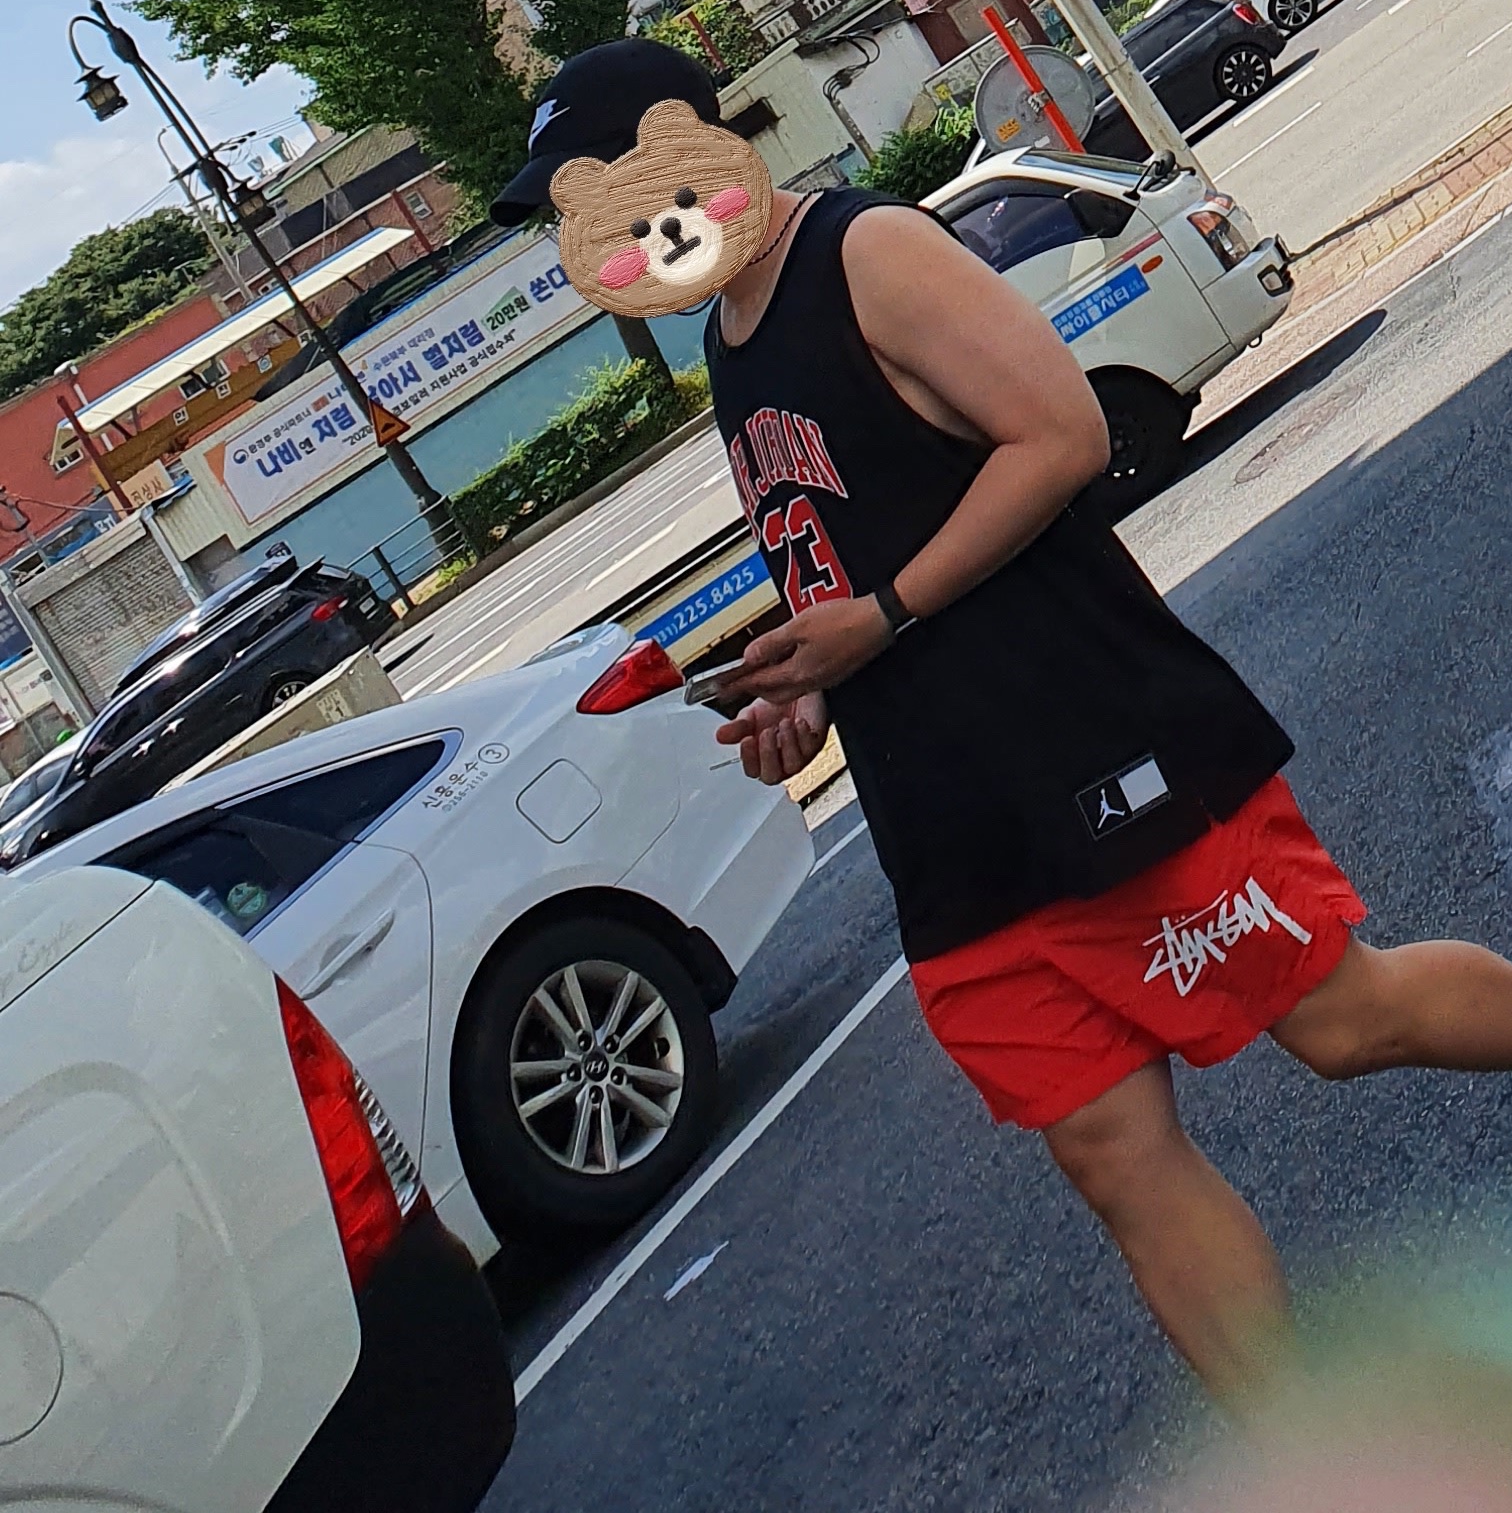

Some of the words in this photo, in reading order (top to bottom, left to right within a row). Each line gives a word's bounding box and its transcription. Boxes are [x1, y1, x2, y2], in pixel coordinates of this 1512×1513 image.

[310, 401, 356, 444] 처럼
[420, 318, 485, 372] 별처럼
[484, 293, 532, 332] 20만원
[428, 362, 468, 392] 지원사업
[765, 495, 844, 603] 23
